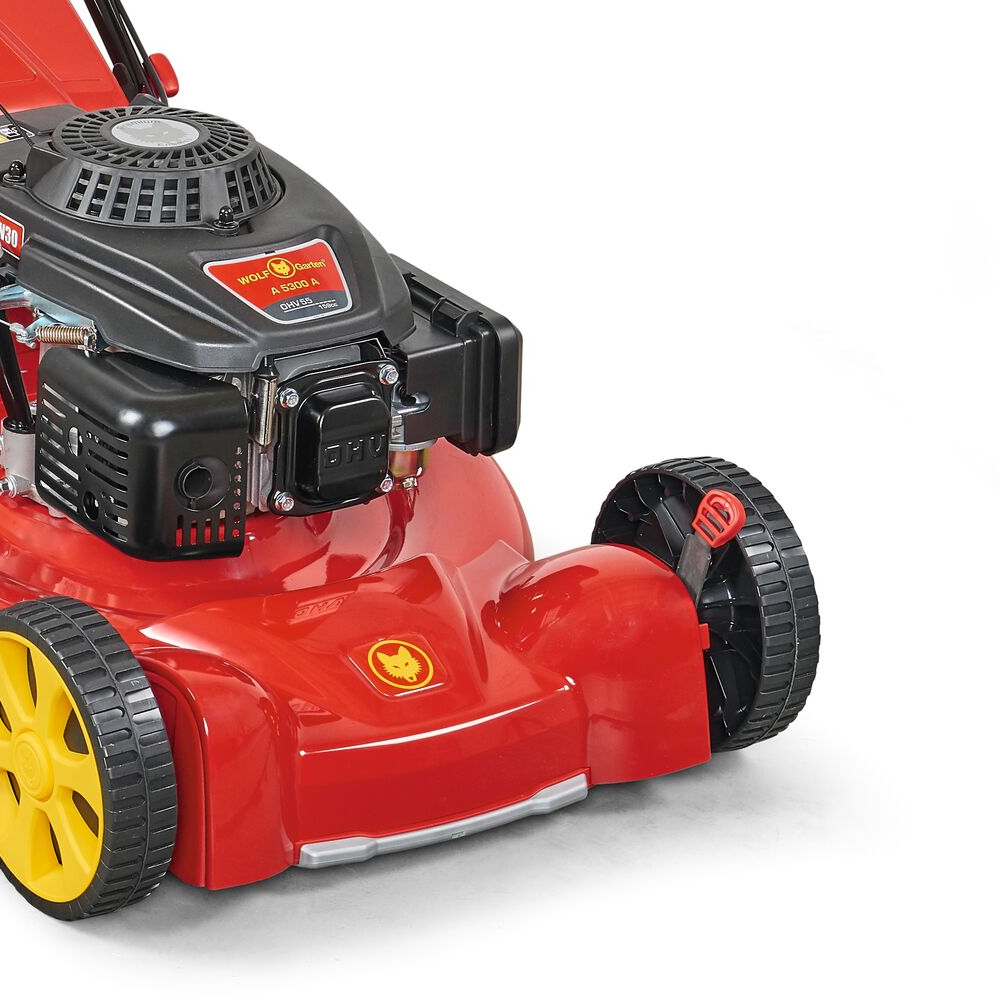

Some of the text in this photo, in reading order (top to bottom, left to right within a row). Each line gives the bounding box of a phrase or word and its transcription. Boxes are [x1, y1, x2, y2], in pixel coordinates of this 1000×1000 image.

[237, 261, 326, 285] WOLF Garten
[271, 278, 320, 295] A 5300 A
[280, 300, 300, 310] OHV
